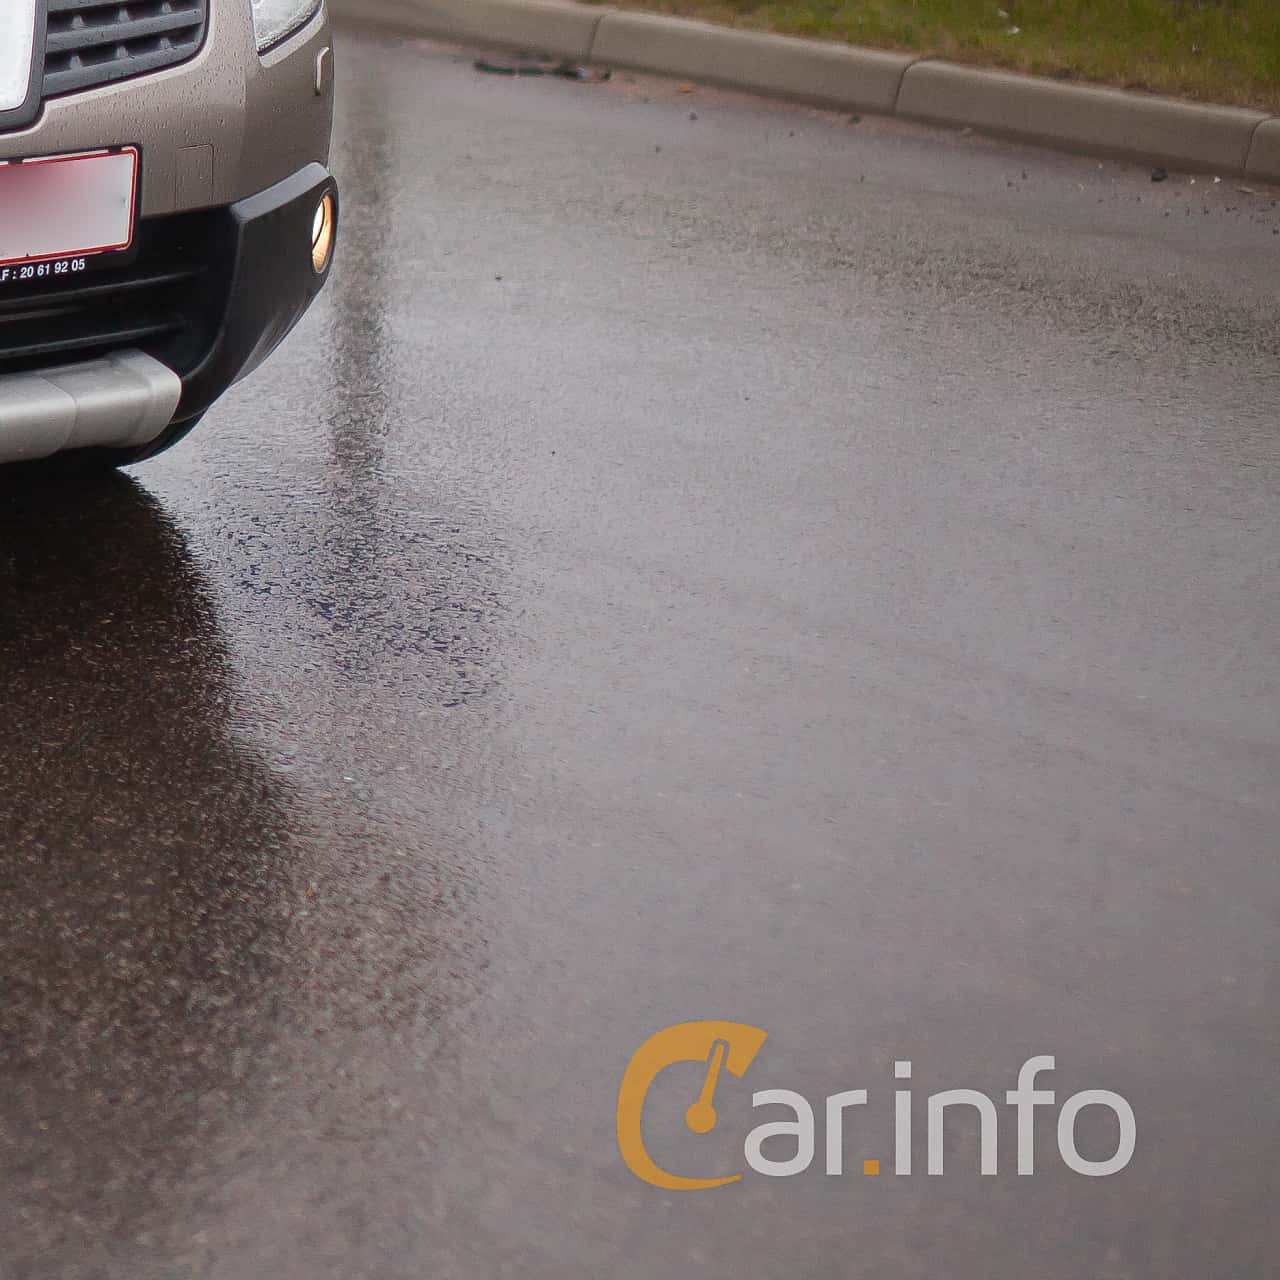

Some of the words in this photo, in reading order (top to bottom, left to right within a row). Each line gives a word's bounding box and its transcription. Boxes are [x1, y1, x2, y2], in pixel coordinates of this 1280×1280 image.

[20, 267, 35, 279] 20
[37, 264, 51, 277] 61
[54, 261, 69, 274] 92
[72, 259, 86, 272] 05
